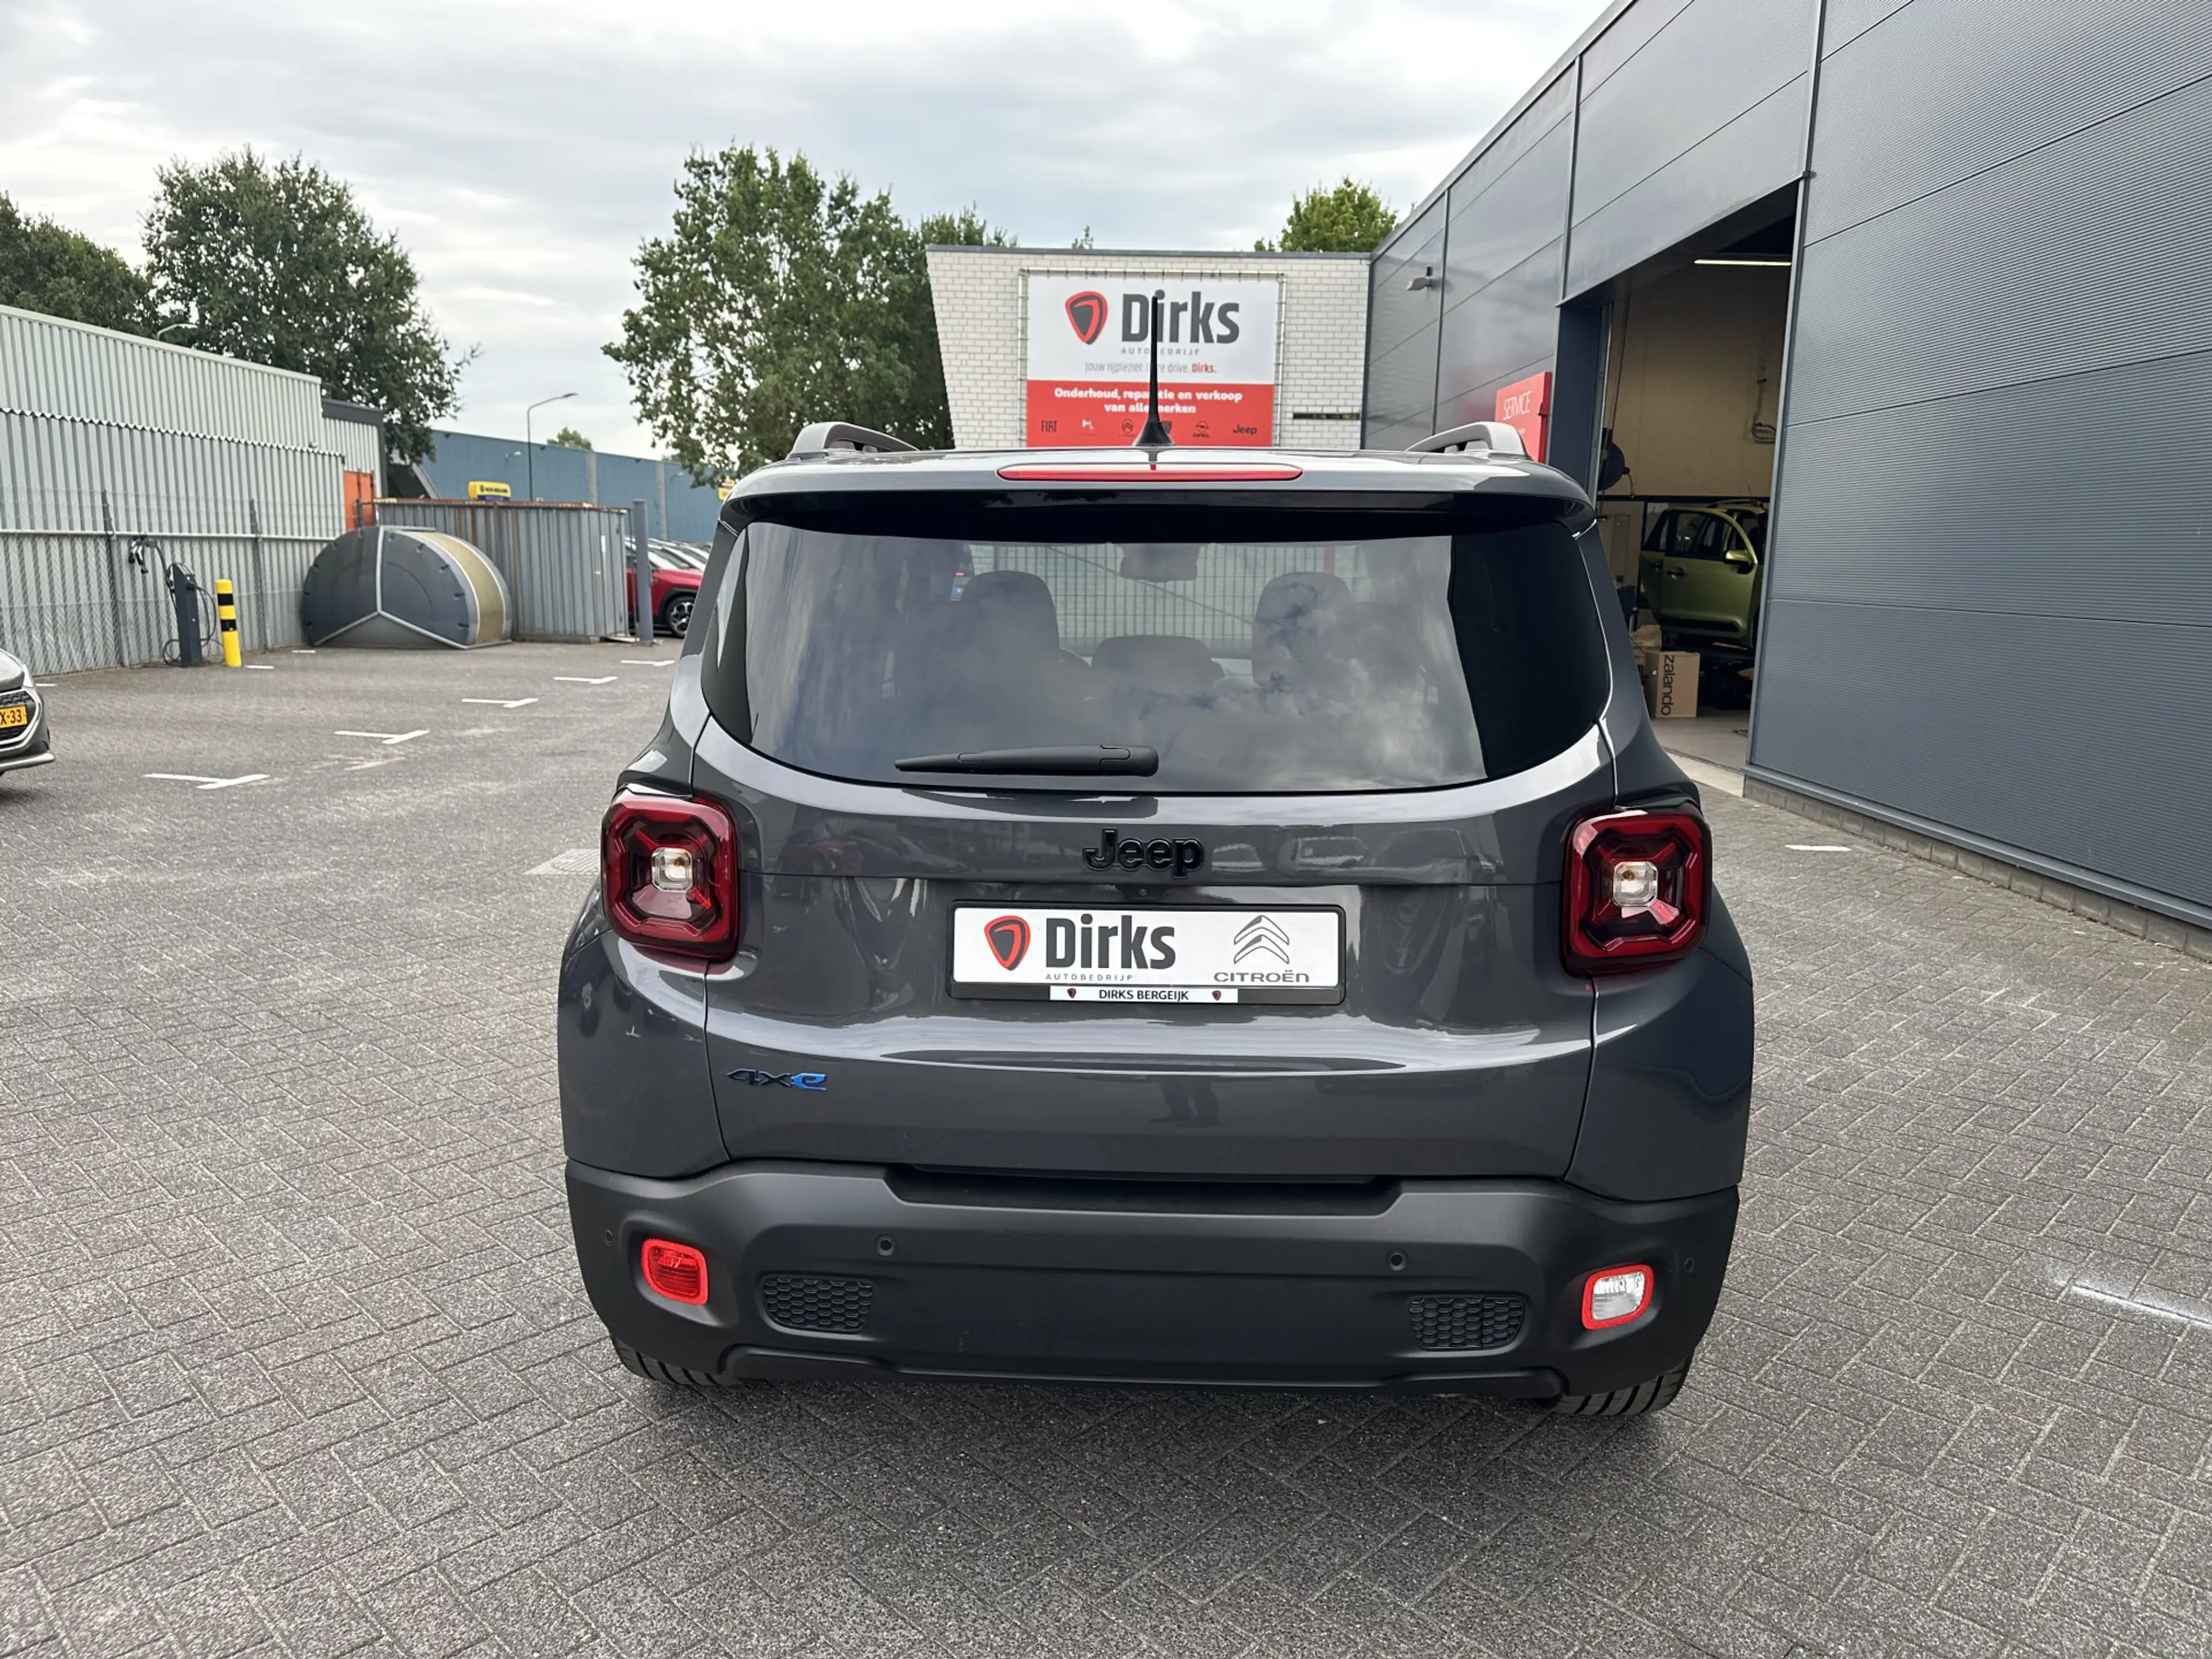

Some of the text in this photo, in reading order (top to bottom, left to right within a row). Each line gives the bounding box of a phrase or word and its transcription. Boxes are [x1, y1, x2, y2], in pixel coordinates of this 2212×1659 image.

[1121, 289, 1240, 344] Dirks
[1120, 347, 1200, 355] AUTOEDRIJF
[1191, 363, 1217, 373] Dirks.
[1054, 388, 1121, 400] Onderhoud,
[1177, 391, 1192, 400] en
[1195, 391, 1243, 403] verkoop
[1104, 404, 1126, 412] van
[1502, 390, 1532, 421] SERVICE
[1041, 420, 1058, 433] FIAT
[1233, 424, 1257, 435] Jeep
[1661, 654, 1676, 716] zalando
[1082, 827, 1205, 880] Jeep
[1046, 913, 1176, 969] Dirks
[1099, 989, 1189, 1002] DIRKS BERGEIJK
